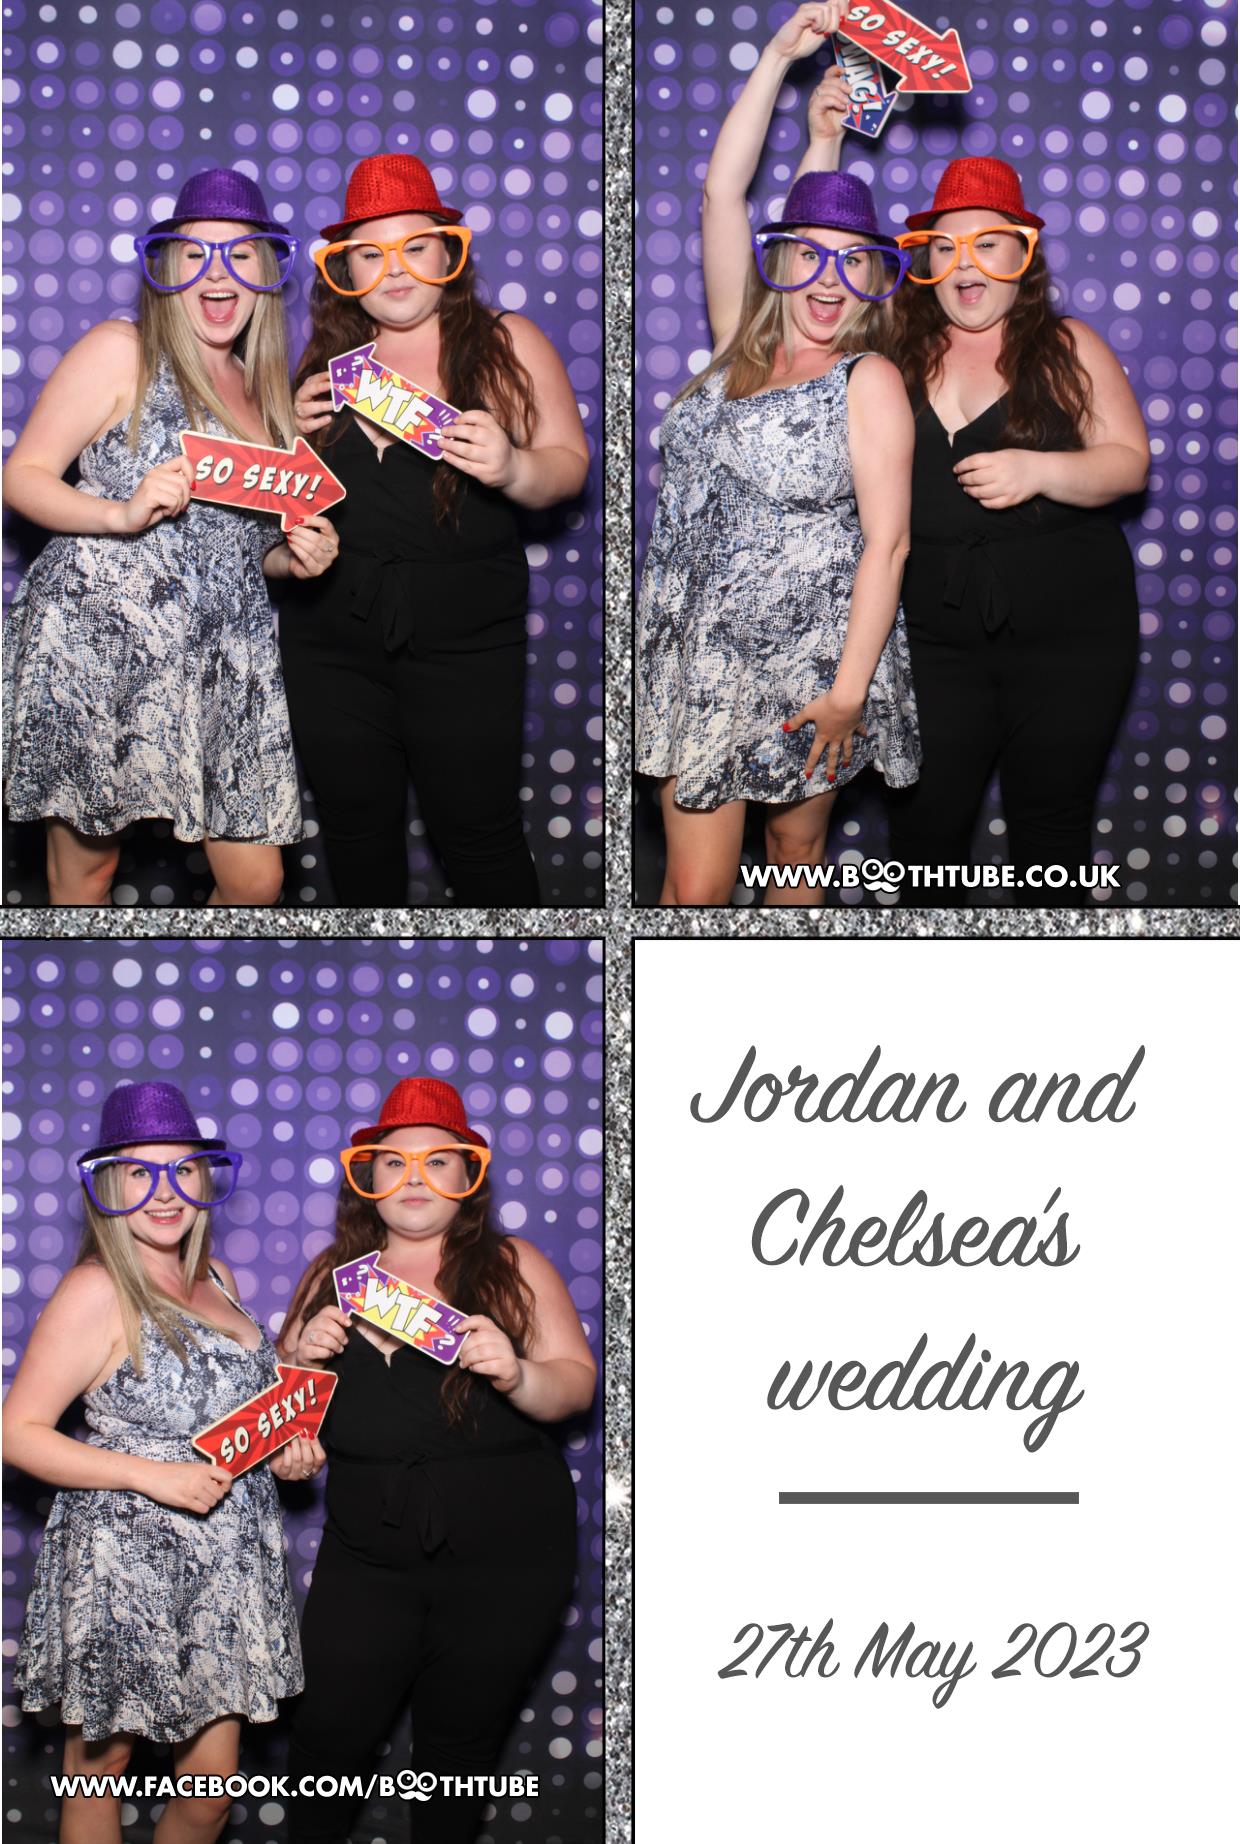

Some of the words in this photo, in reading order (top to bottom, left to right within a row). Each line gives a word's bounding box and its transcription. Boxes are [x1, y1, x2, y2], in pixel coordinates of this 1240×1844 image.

[847, 6, 886, 31] SO
[882, 30, 957, 80] SEXY!
[195, 455, 234, 484] SO
[243, 464, 323, 500] SEXY!
[221, 1426, 249, 1463] SO
[257, 1379, 317, 1438] SEXY!
